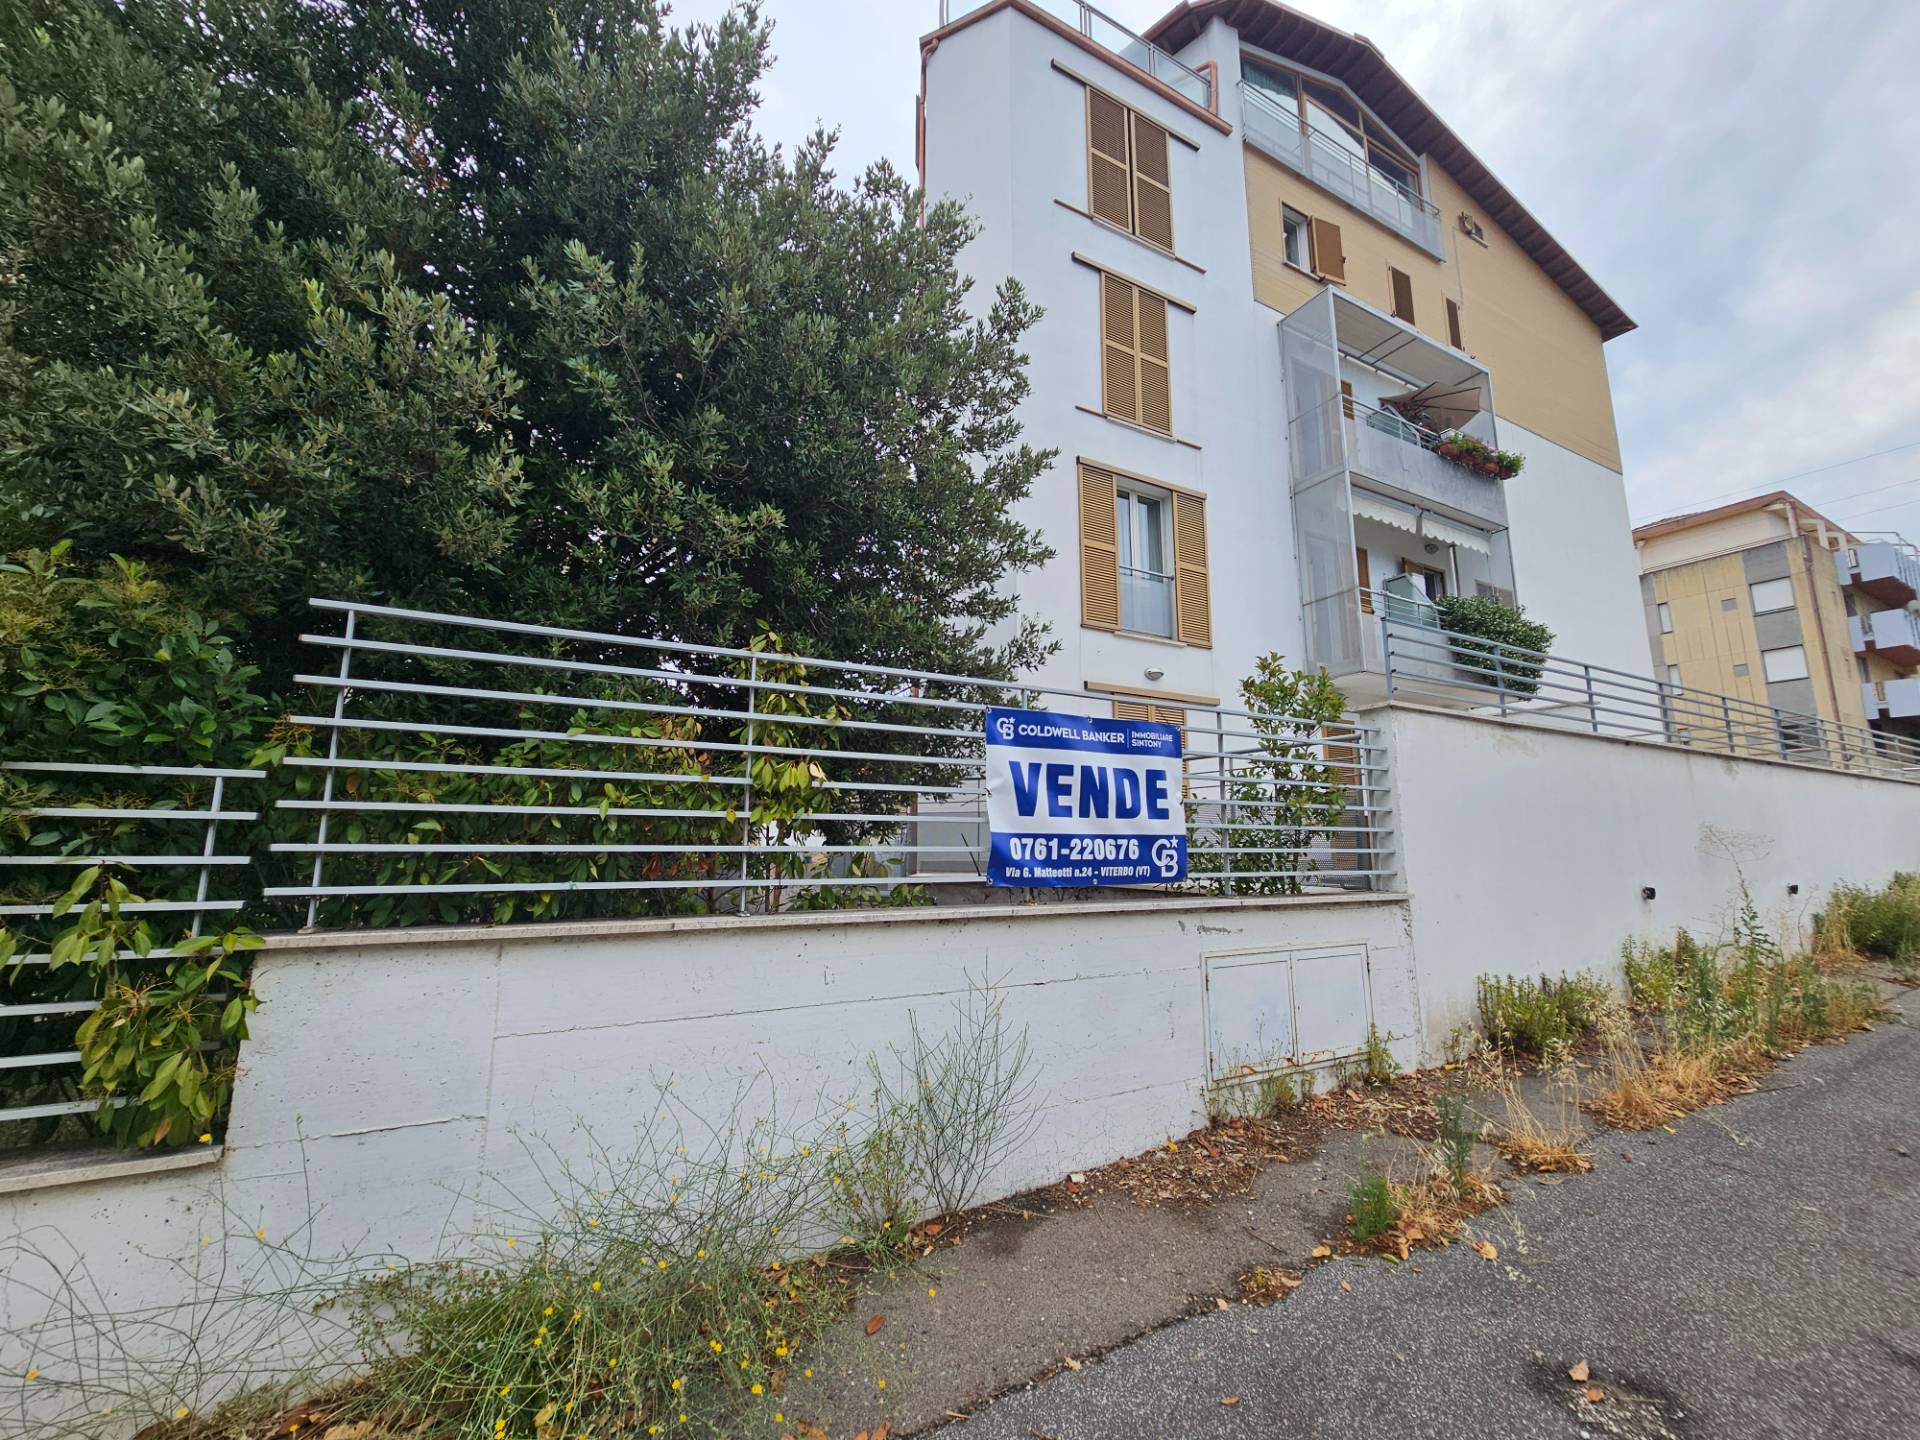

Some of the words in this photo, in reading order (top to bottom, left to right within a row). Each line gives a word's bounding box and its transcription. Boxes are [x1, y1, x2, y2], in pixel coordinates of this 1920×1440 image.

[1018, 723, 1081, 740] COLDWELL
[1082, 730, 1125, 743] BANKER
[1131, 730, 1173, 742] IMMOBILIARE
[1131, 739, 1162, 748] SINTONY
[1008, 760, 1170, 820] VENDE
[1009, 837, 1140, 861] 0761-220676
[1005, 866, 1021, 878] Via
[1022, 867, 1032, 878] G.
[1033, 866, 1073, 878] Matteotti
[1074, 867, 1093, 878] n.24
[1100, 866, 1134, 877] VITERBO
[1135, 865, 1151, 878] (VT)
